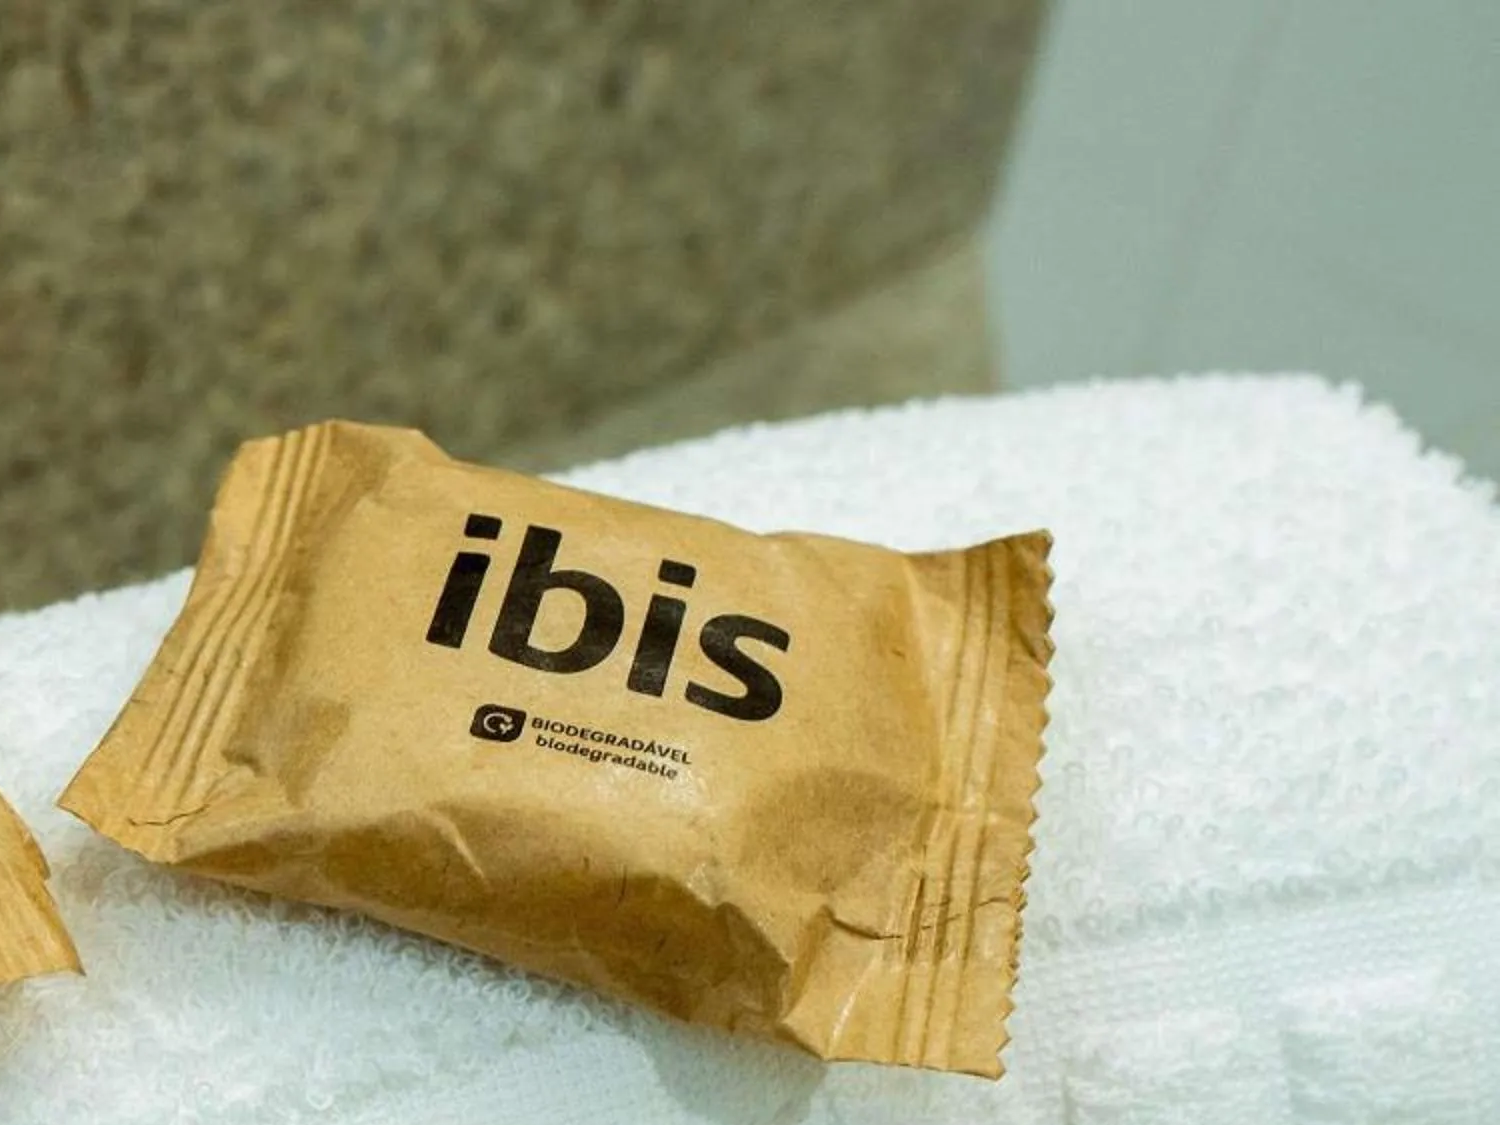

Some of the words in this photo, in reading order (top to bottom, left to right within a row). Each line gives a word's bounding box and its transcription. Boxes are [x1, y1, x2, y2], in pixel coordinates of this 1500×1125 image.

[425, 512, 791, 723] ibis
[531, 716, 692, 765] BIODEGRADÁVEL
[535, 734, 678, 780] biodegradable
